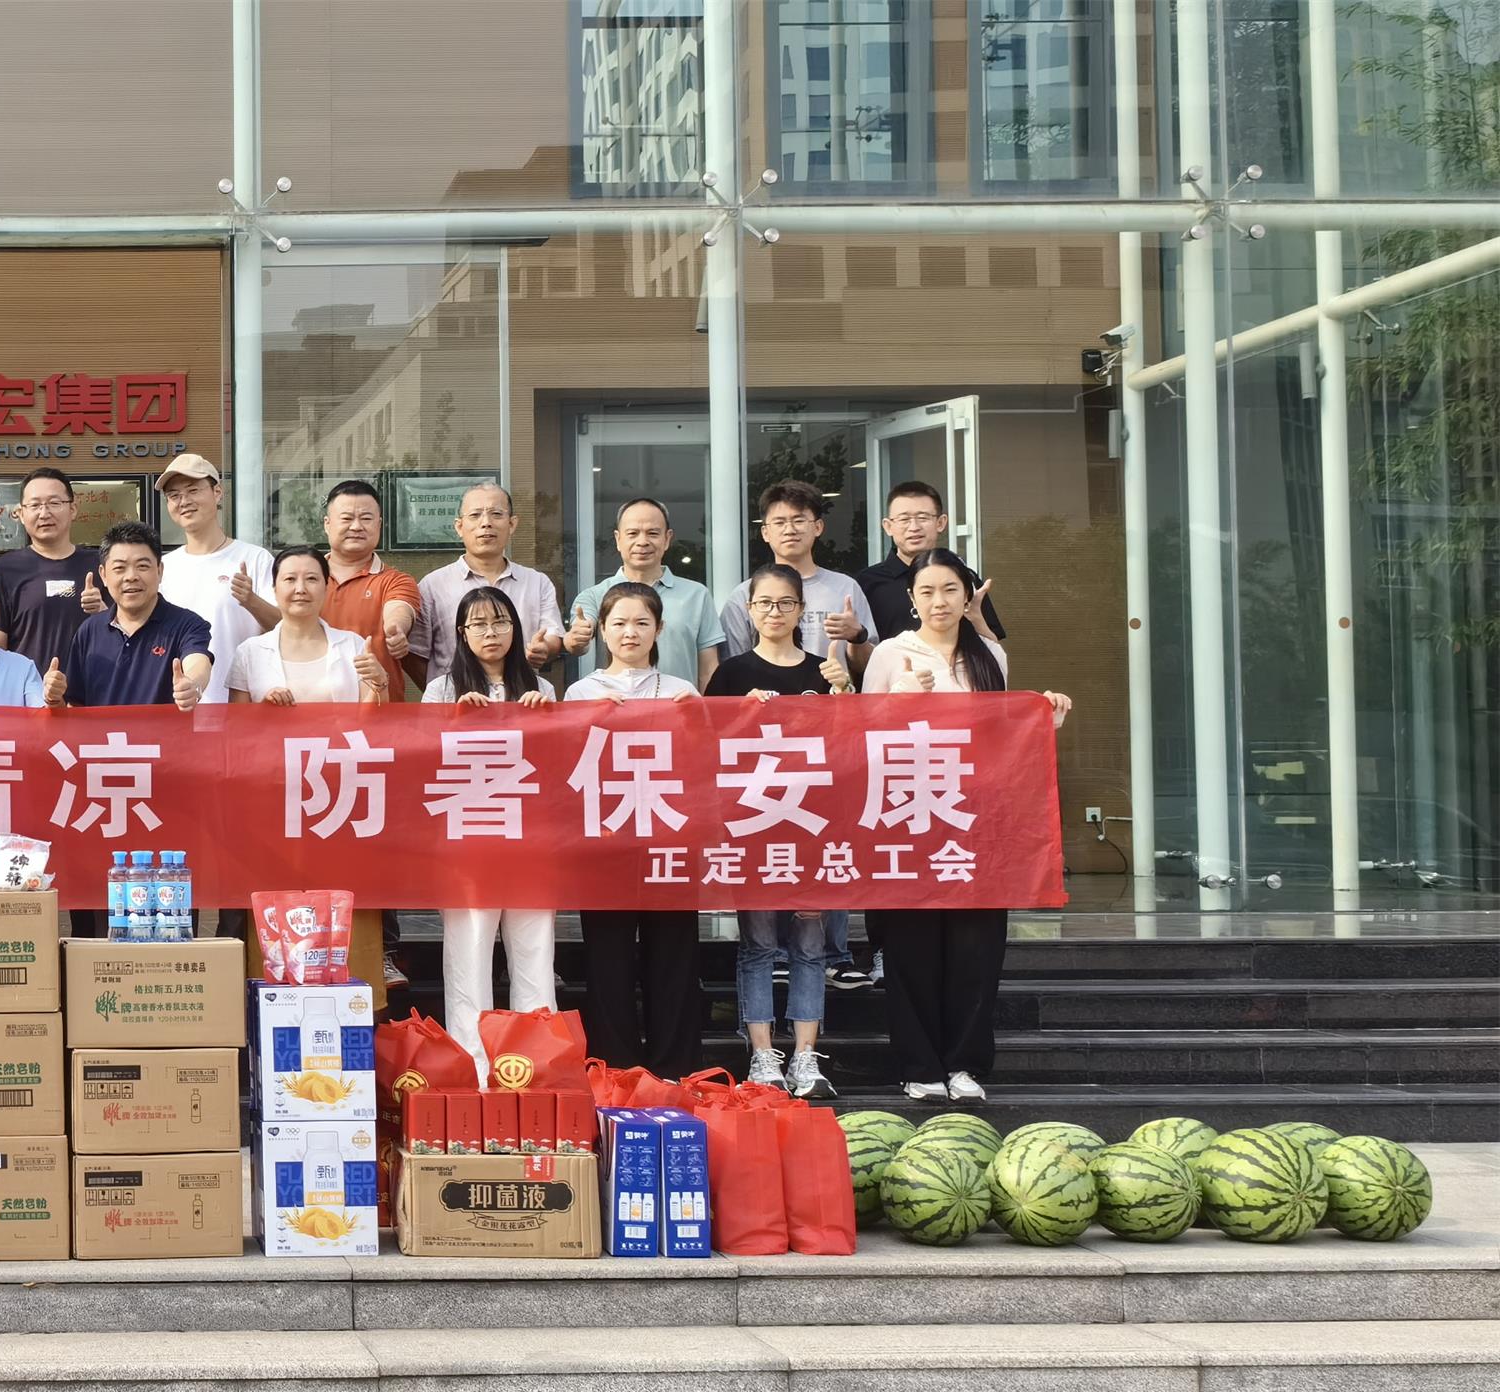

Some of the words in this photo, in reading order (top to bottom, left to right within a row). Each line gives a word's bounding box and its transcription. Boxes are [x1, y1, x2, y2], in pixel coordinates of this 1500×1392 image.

[92, 440, 188, 458] GROUP
[283, 722, 977, 840] 防暑保安康
[645, 842, 977, 884] 正定县总工会
[304, 950, 319, 961] 120
[175, 961, 206, 973] 非单卖品
[134, 984, 204, 994] 格拉斯五月玫瑰
[468, 1184, 546, 1209] 抑菌液
[1, 1198, 48, 1211] 天然皂粉
[481, 1219, 536, 1230] 金银花花露型
